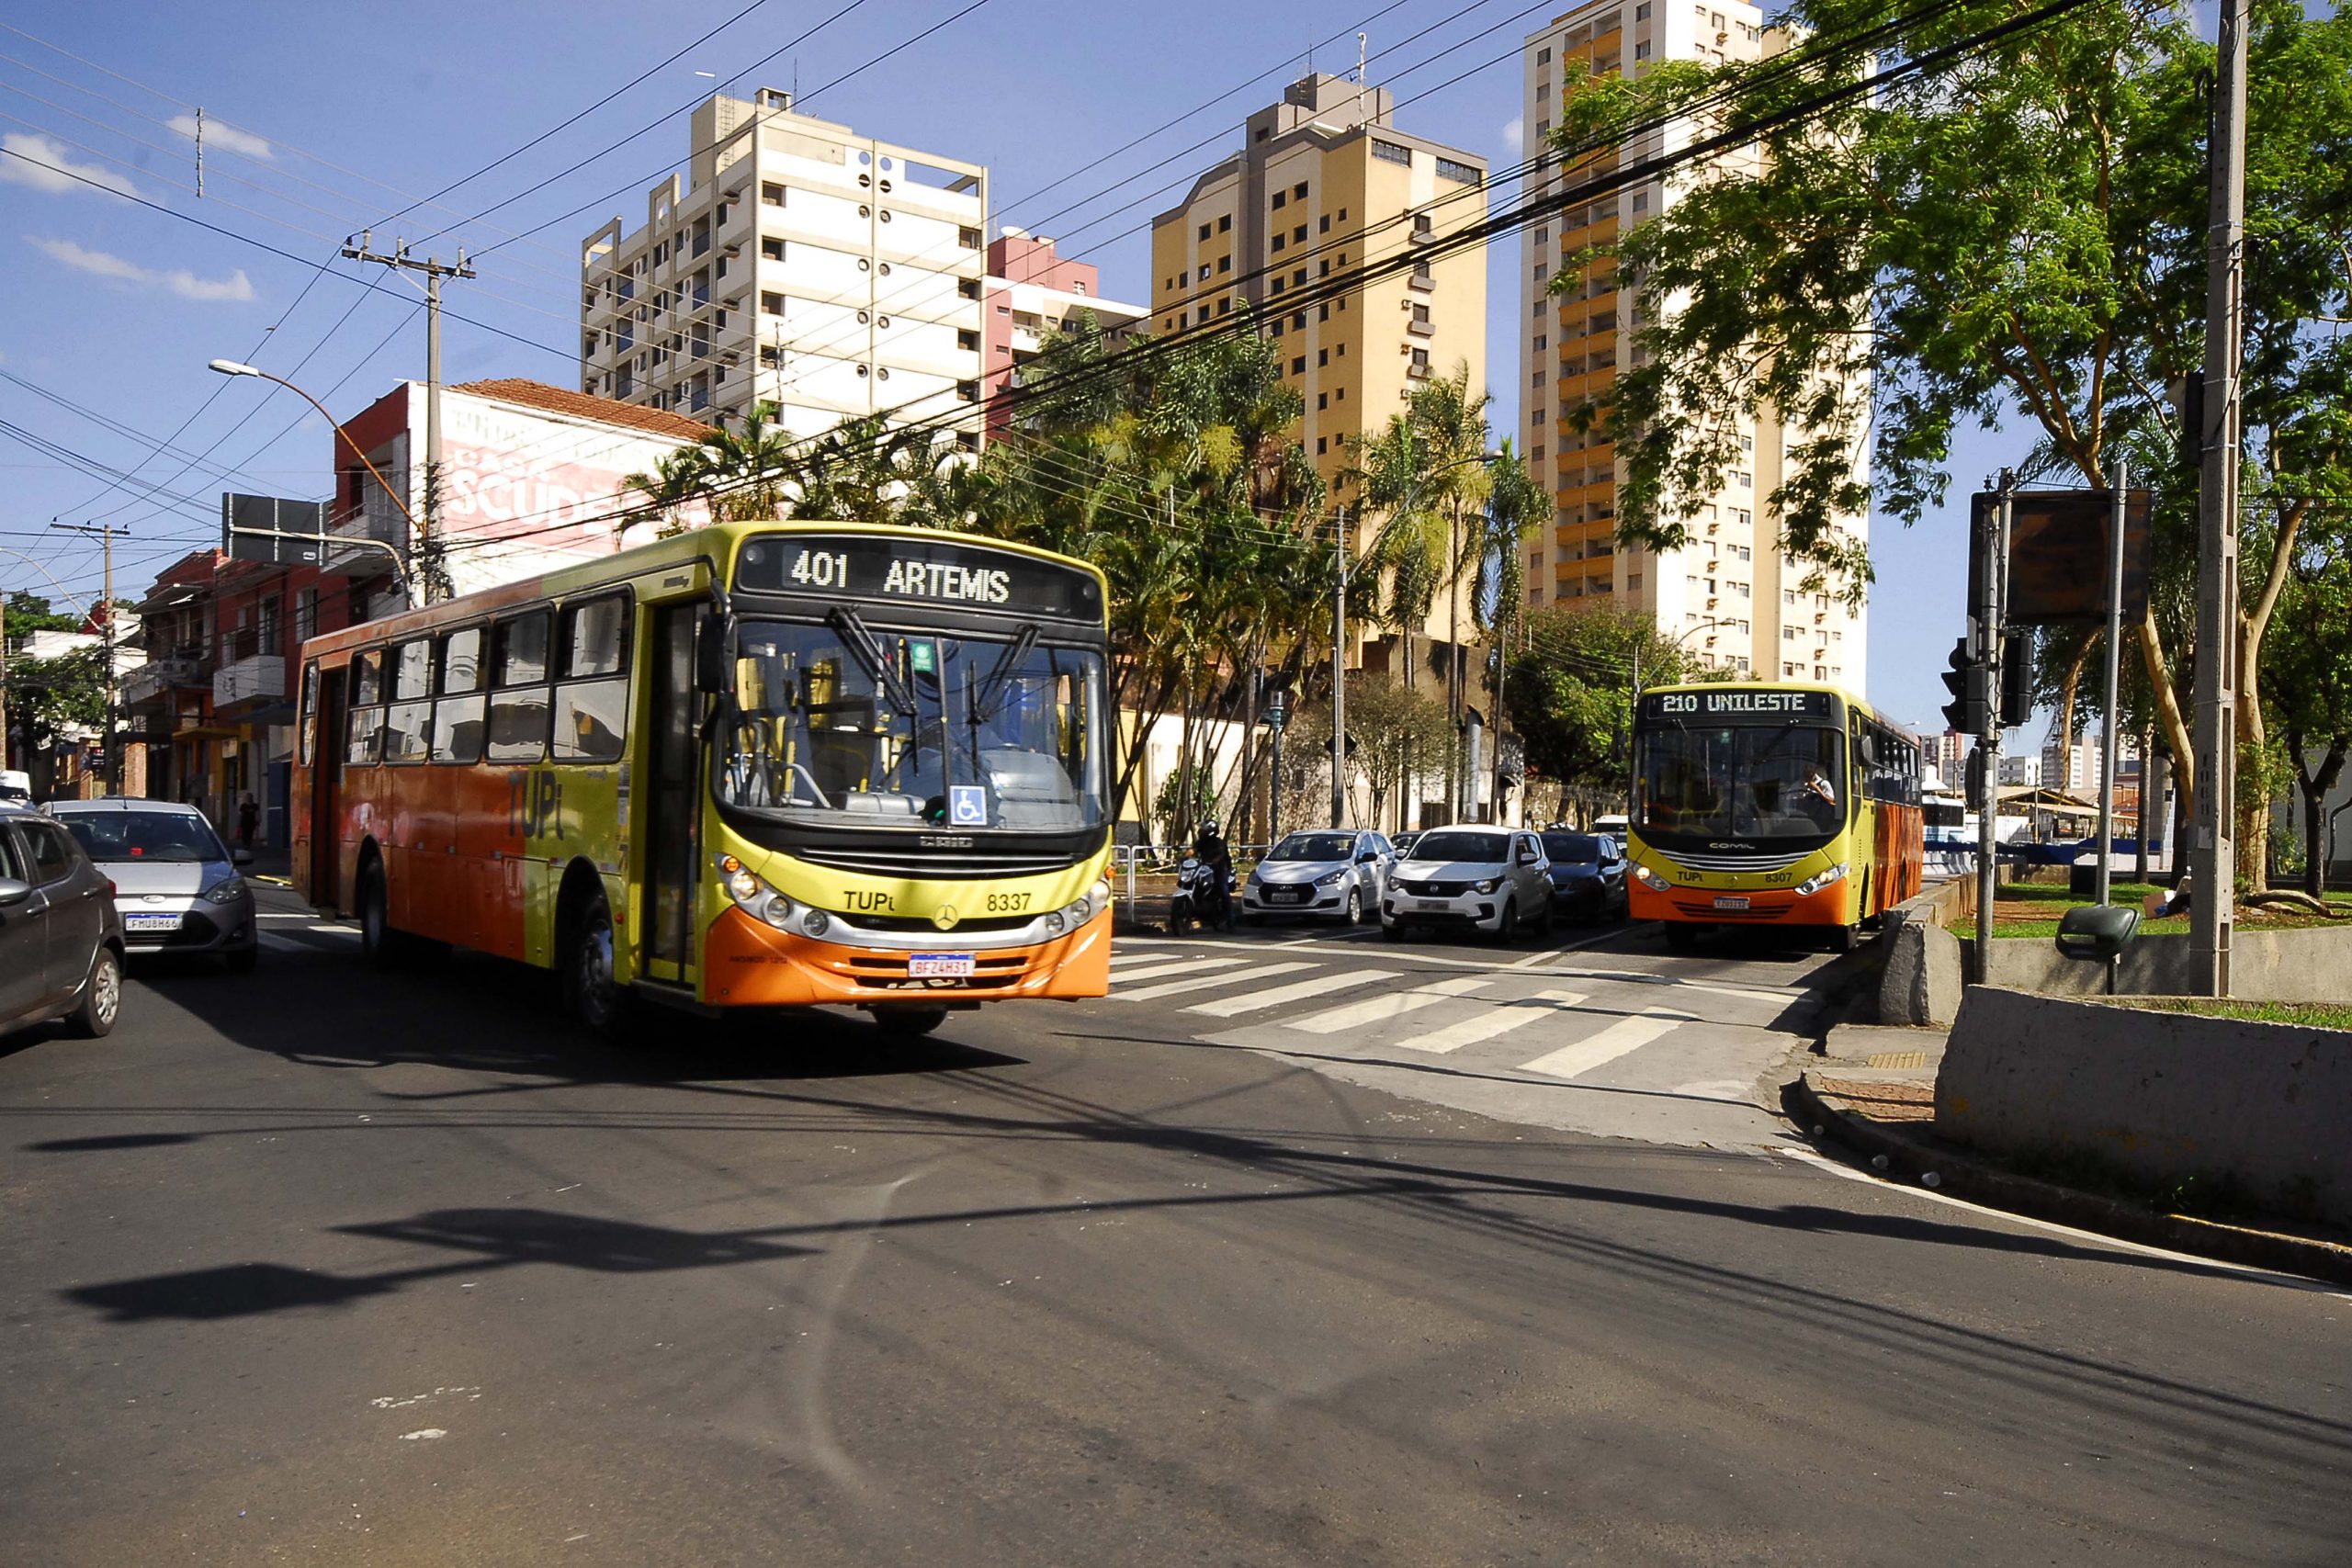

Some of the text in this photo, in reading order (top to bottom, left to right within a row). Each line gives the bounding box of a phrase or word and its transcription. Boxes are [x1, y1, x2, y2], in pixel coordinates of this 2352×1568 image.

[448, 468, 628, 536] SCUDE
[791, 549, 1010, 604] 401 ARTEMIS
[1663, 694, 1805, 712] 210 UNILESTE
[1765, 873, 1792, 883] 8307
[987, 893, 1031, 911] 8337
[915, 961, 967, 975] BFZ4H31
